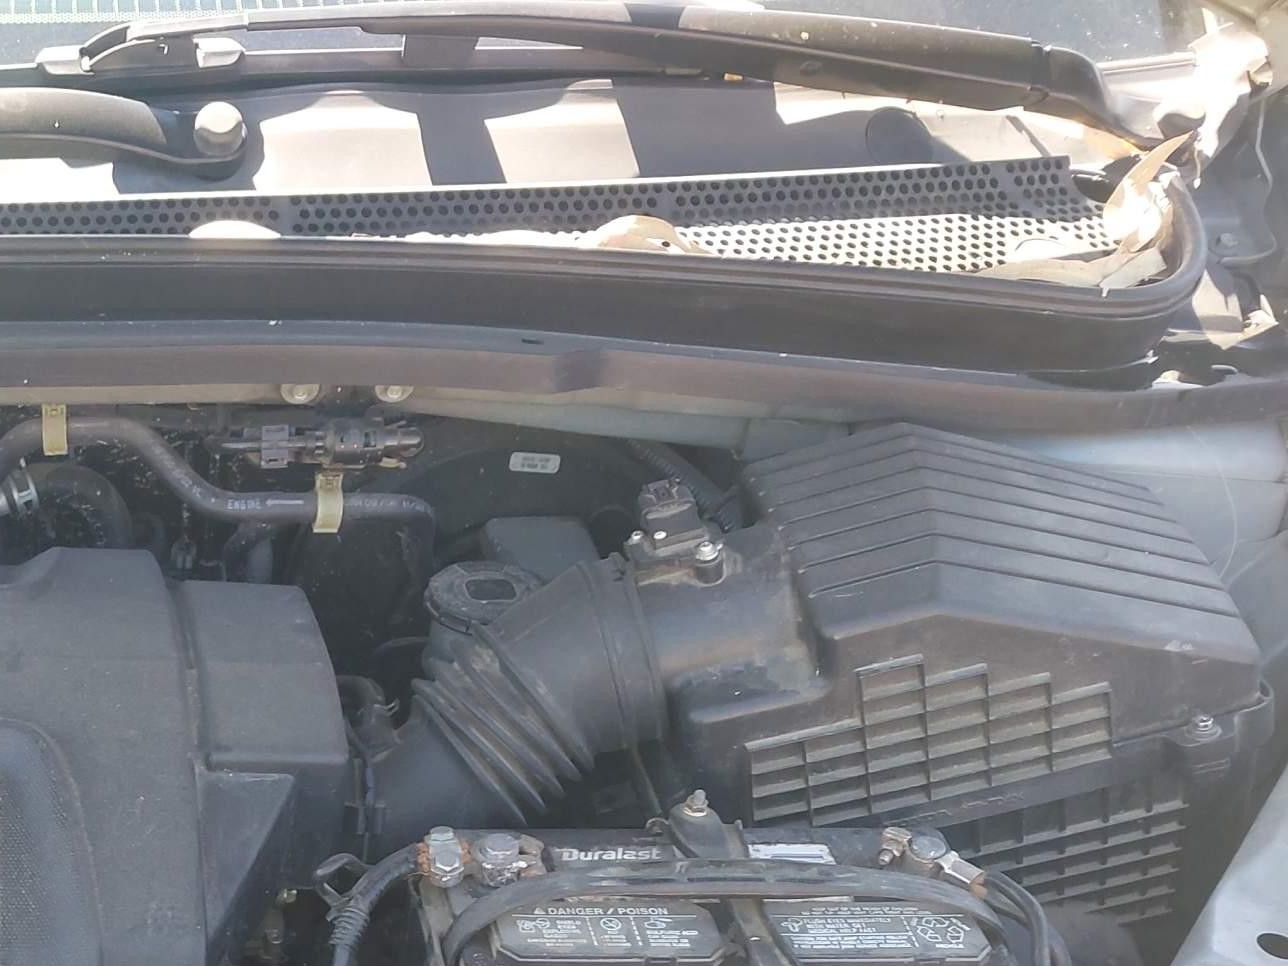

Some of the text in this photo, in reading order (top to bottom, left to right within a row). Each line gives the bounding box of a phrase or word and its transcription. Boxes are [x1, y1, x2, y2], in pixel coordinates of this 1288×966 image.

[561, 847, 663, 861] Duralast
[548, 907, 604, 915] DANGER
[617, 907, 669, 915] POISON
